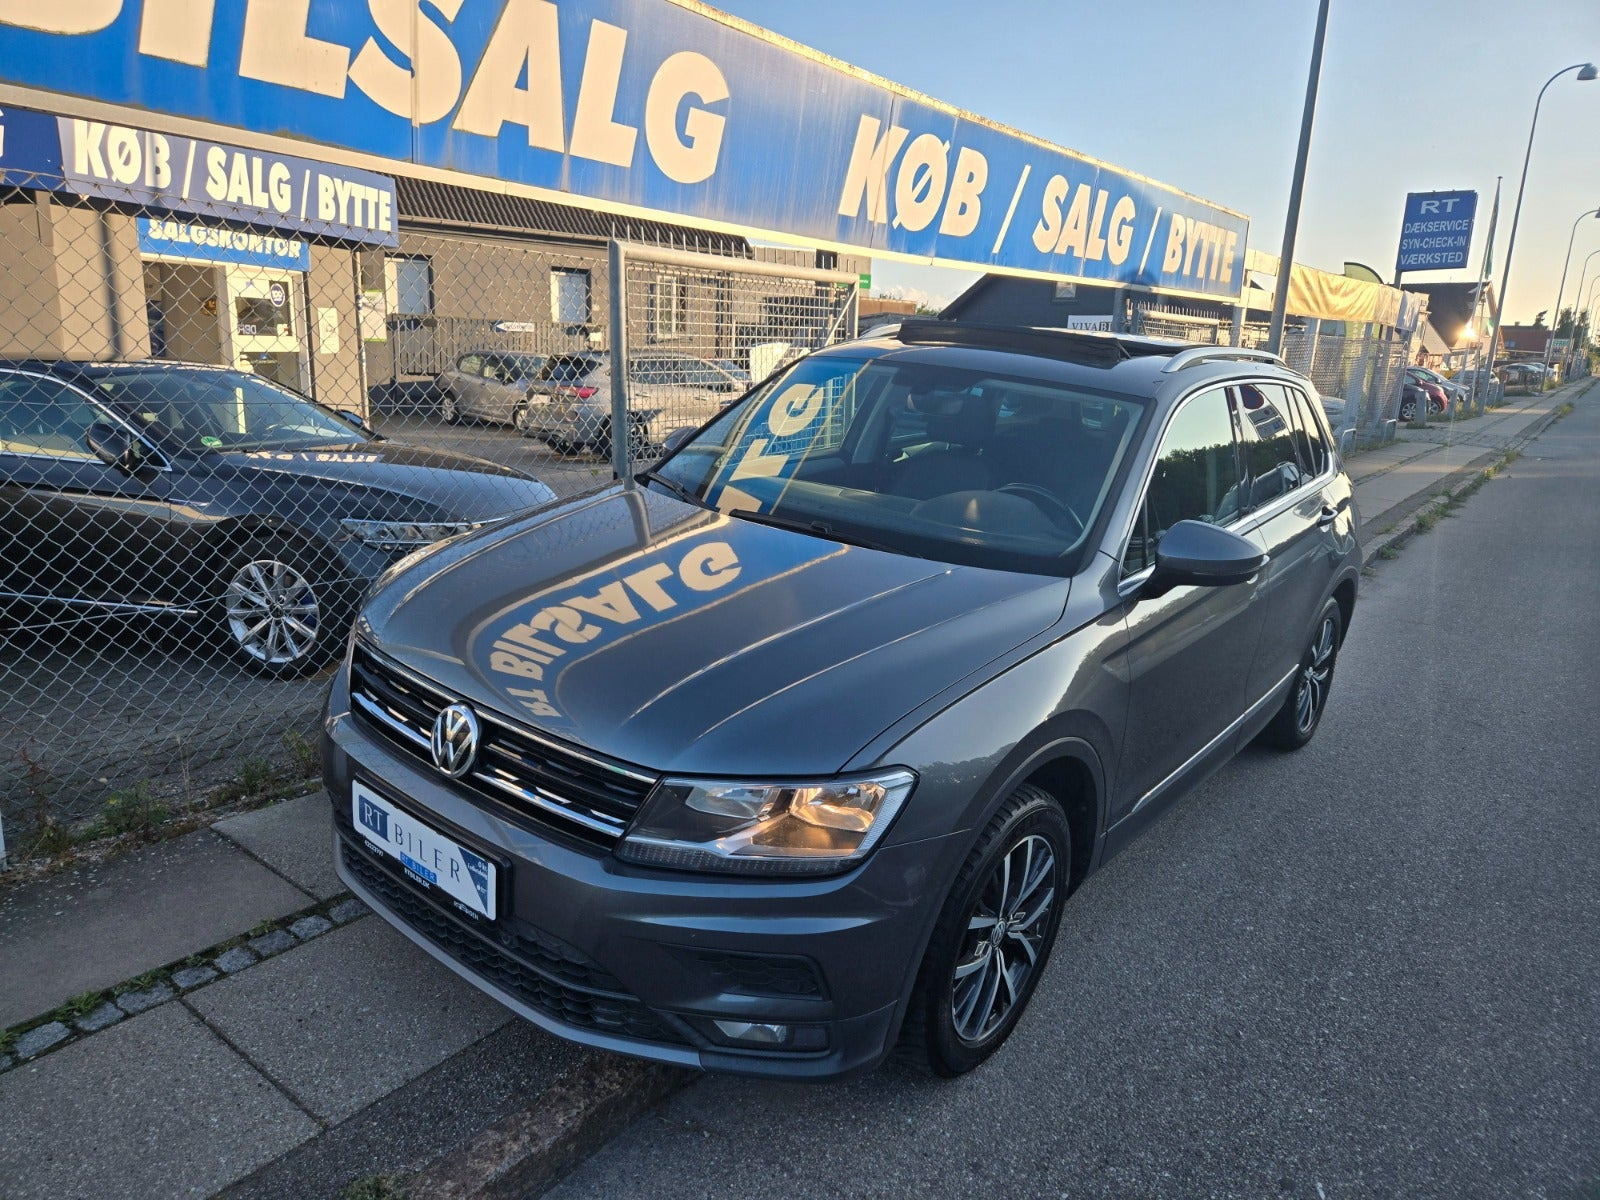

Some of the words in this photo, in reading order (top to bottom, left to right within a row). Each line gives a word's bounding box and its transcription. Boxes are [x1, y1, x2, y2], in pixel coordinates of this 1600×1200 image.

[74, 119, 172, 190] KØB
[205, 146, 292, 213] SALG
[318, 174, 392, 232] BYTTE
[838, 114, 989, 237] KØB
[1032, 174, 1136, 265] SALG
[1162, 213, 1239, 283] BYTTE
[1420, 198, 1460, 215] RT
[148, 219, 302, 259] SALGSKONTOR
[1404, 219, 1469, 234] DÆKSERVICE
[1402, 236, 1467, 250] SYN-CHECK-IN
[1401, 251, 1463, 265] VÆRKSTED
[364, 802, 384, 832] RT
[394, 822, 461, 884] BILER
